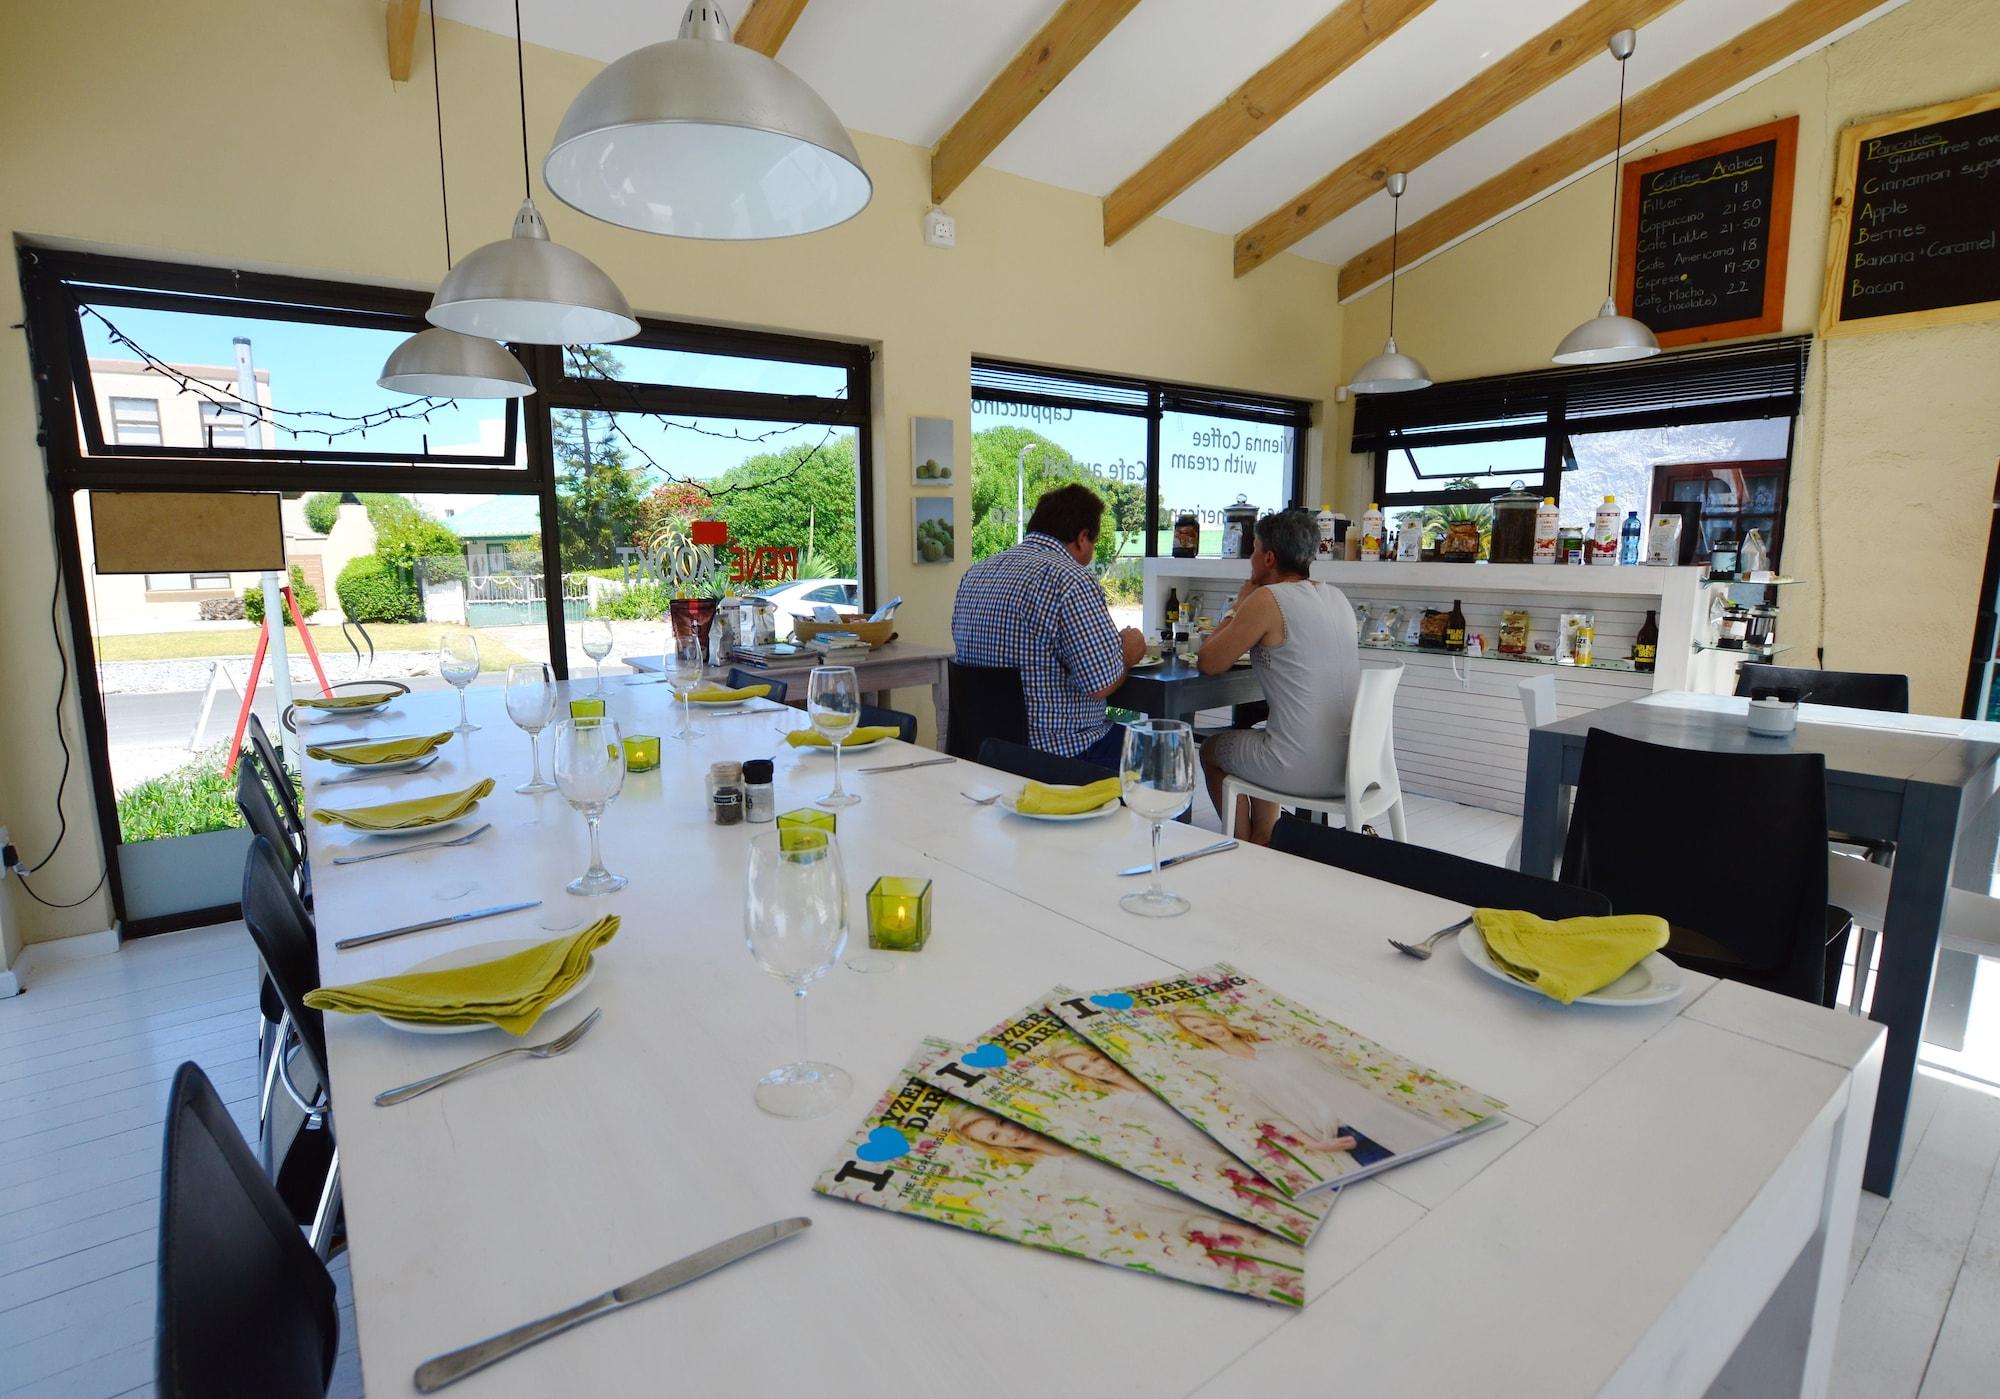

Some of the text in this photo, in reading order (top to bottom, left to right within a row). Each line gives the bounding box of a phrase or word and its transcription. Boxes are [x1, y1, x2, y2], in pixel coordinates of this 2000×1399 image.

[1867, 132, 1942, 160] Pancakes
[1888, 149, 1935, 174] gluten
[1938, 140, 1970, 155] free
[1651, 154, 1763, 191] Coffee Arabica
[1863, 168, 1951, 195] Cinnamon
[1642, 180, 1749, 215] Filter 18
[1640, 211, 1705, 238] Cappuccino
[1859, 199, 1909, 227] Apple
[1672, 230, 1709, 246] Latte
[1853, 223, 1926, 246] Berries
[1674, 247, 1735, 266] Americano
[1742, 238, 1758, 253] 18
[1854, 229, 1996, 269] Banana Caramel
[1726, 280, 1749, 295] 22
[1851, 278, 1905, 298] Bacon
[1141, 976, 1248, 1006] DARLING
[1060, 997, 1102, 1019] I
[935, 1062, 986, 1088] I
[834, 1160, 894, 1192] I
[898, 1180, 916, 1199] THE
[933, 1127, 952, 1149] ISSUE
